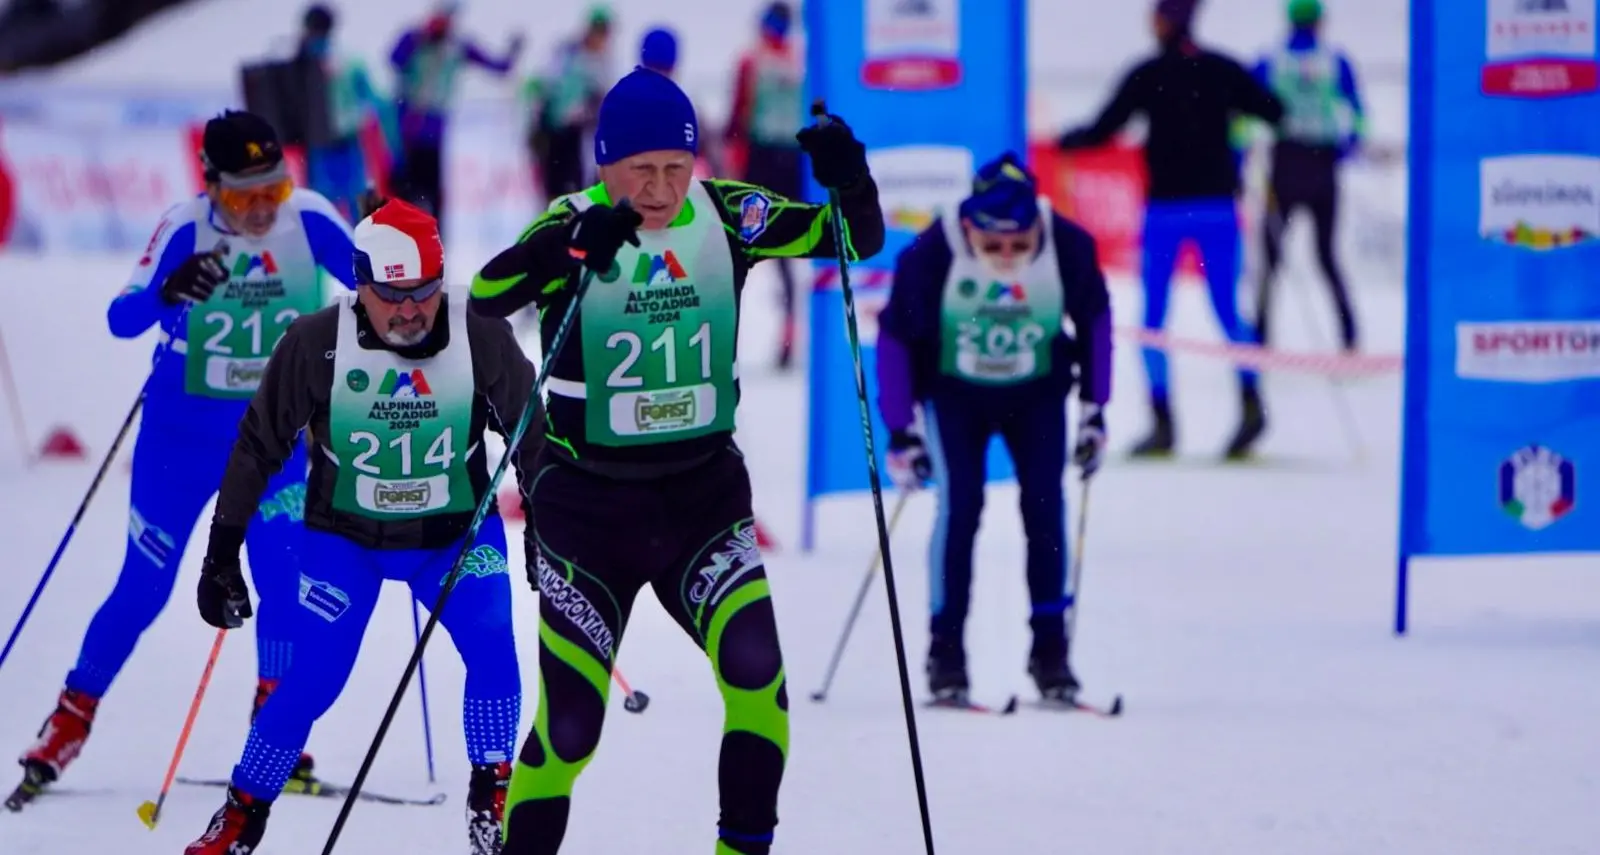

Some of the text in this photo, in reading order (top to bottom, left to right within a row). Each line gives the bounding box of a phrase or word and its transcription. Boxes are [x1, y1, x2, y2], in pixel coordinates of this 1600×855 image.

[627, 285, 695, 303] ALPINIADI
[624, 296, 700, 315] ALTO ADIGE
[647, 311, 681, 324] 2024
[605, 322, 712, 388] 211
[367, 408, 439, 420] ALTO ADIGE
[372, 401, 436, 411] ALPINIADI
[640, 401, 692, 421] FORST
[388, 420, 420, 430] 2024
[348, 426, 456, 476] 214
[378, 488, 427, 504] FORST
